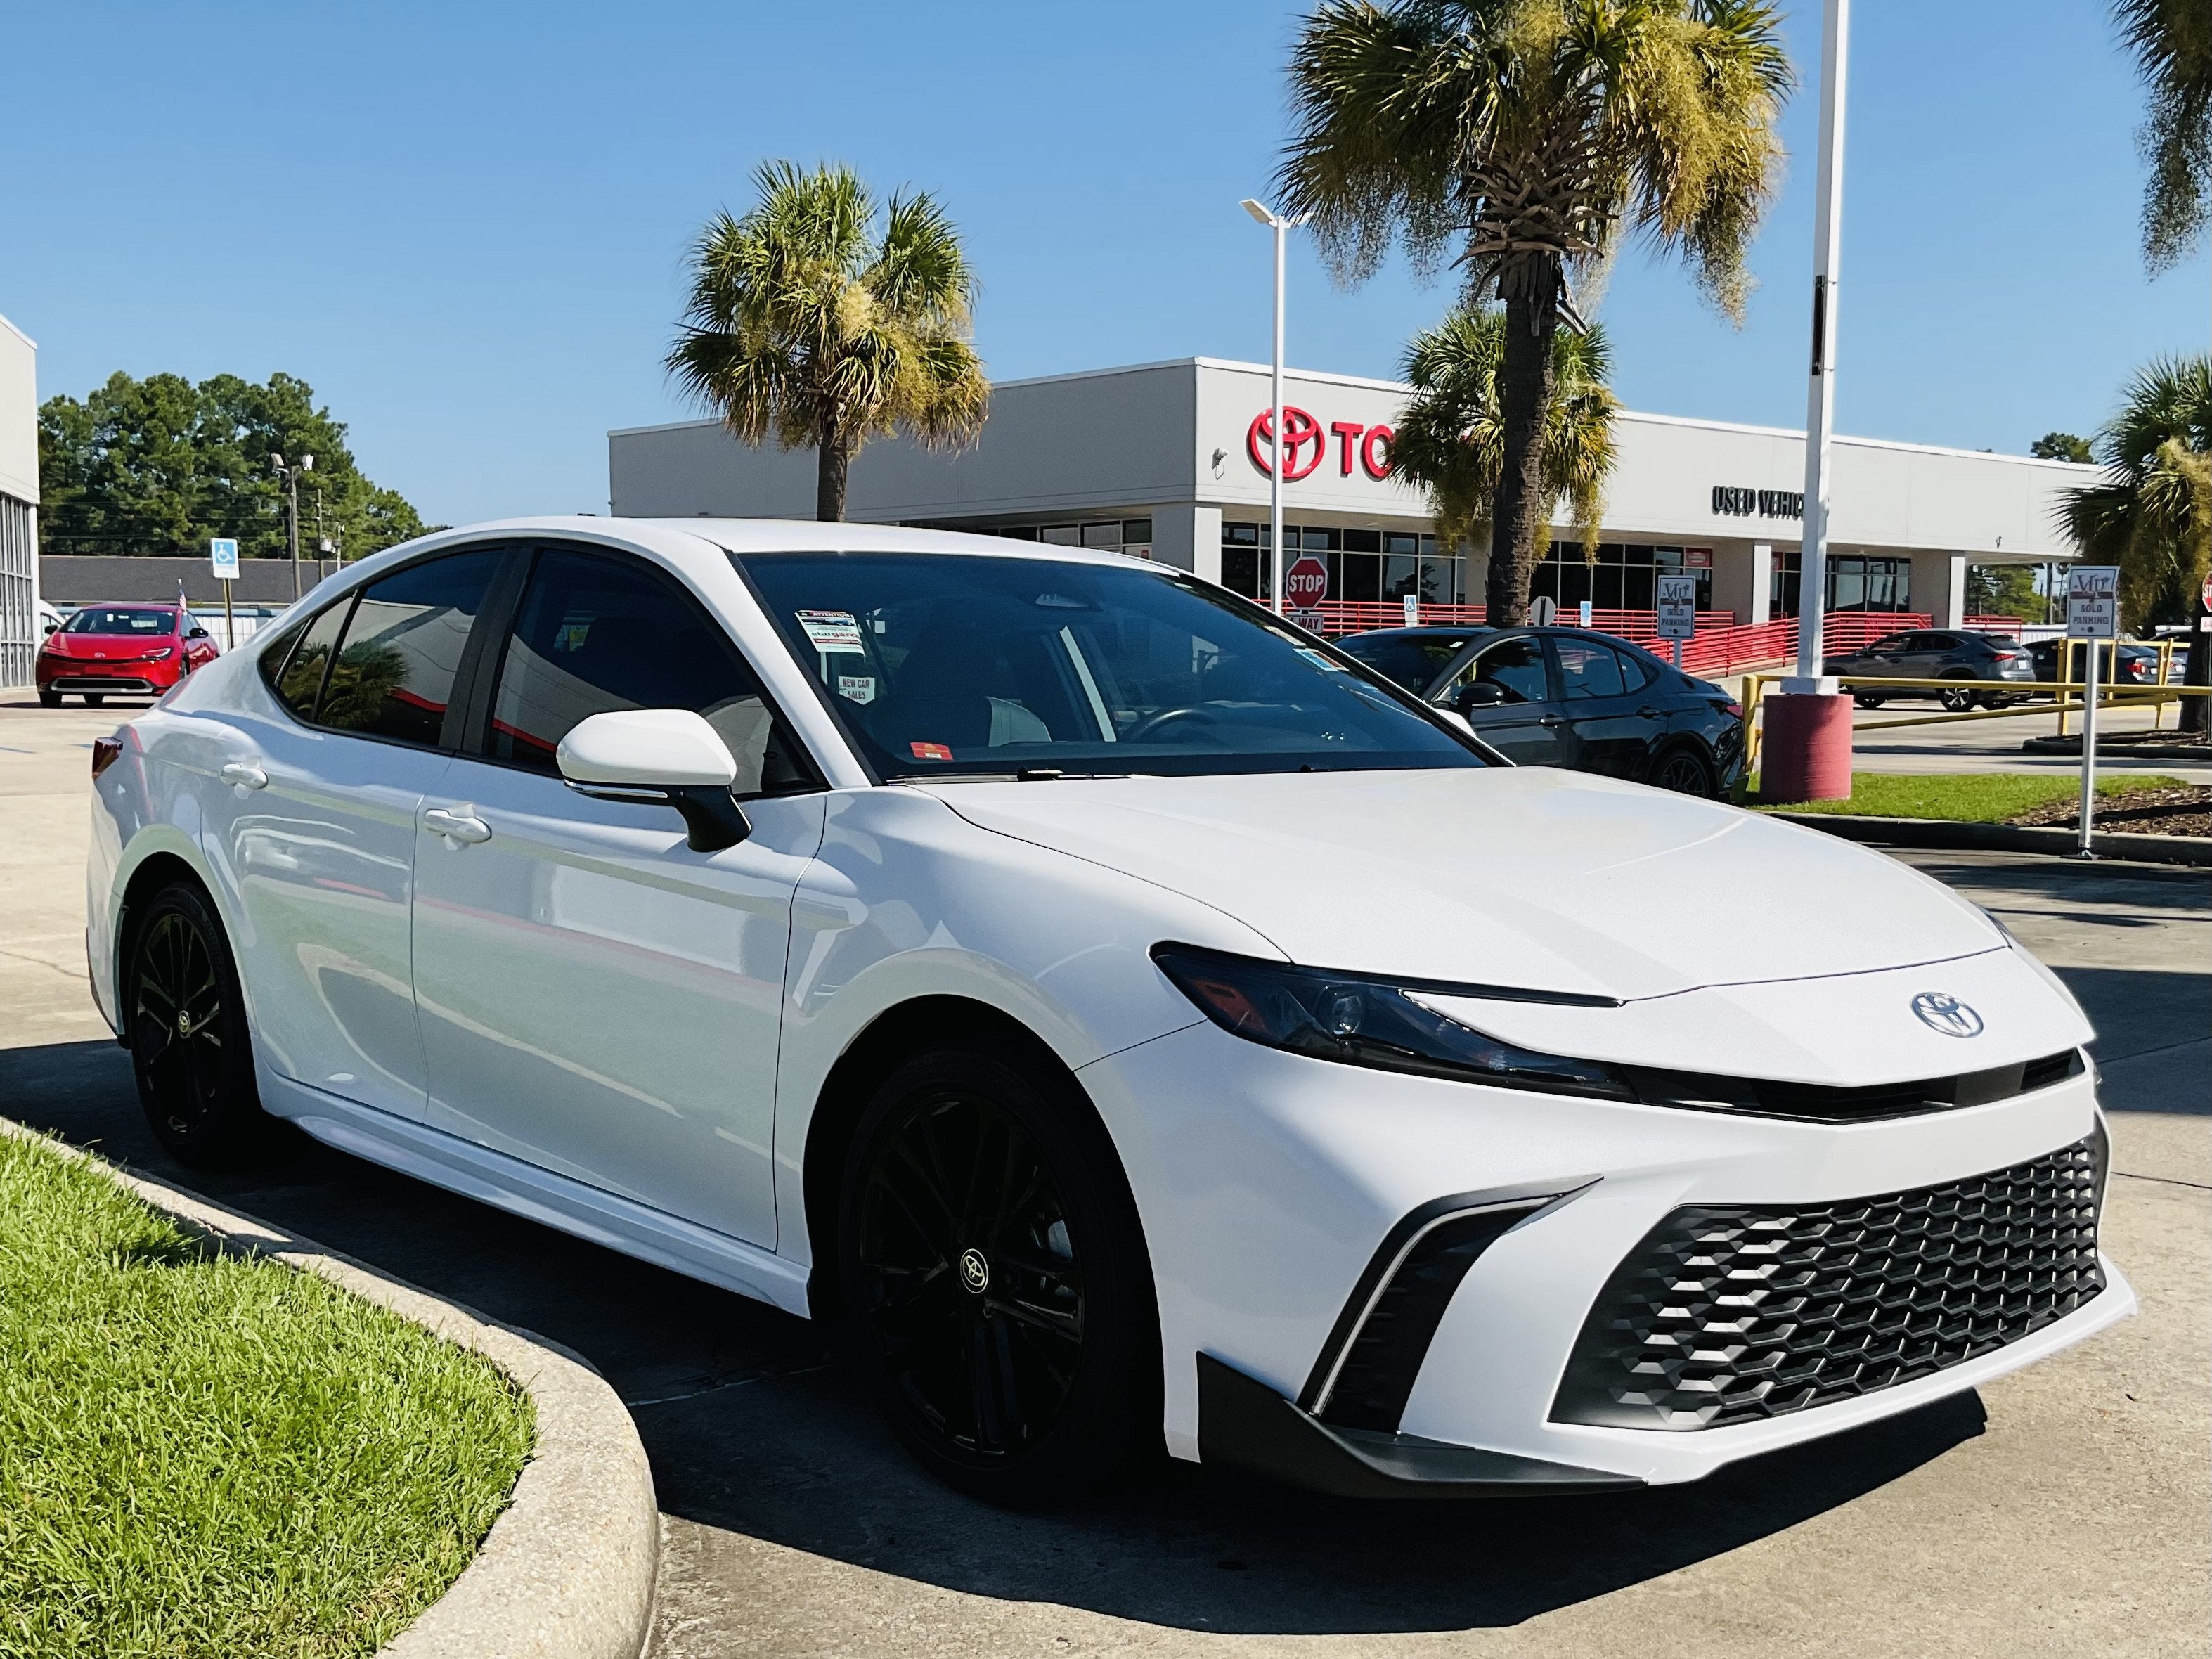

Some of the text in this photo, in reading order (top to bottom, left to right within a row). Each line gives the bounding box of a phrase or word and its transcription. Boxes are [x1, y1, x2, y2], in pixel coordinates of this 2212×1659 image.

[1712, 486, 1756, 515] USED
[1289, 574, 1324, 593] STOP
[1299, 618, 1319, 630] WAY
[843, 678, 855, 688] NEW
[858, 679, 870, 689] CAR
[848, 691, 866, 699] SALES
